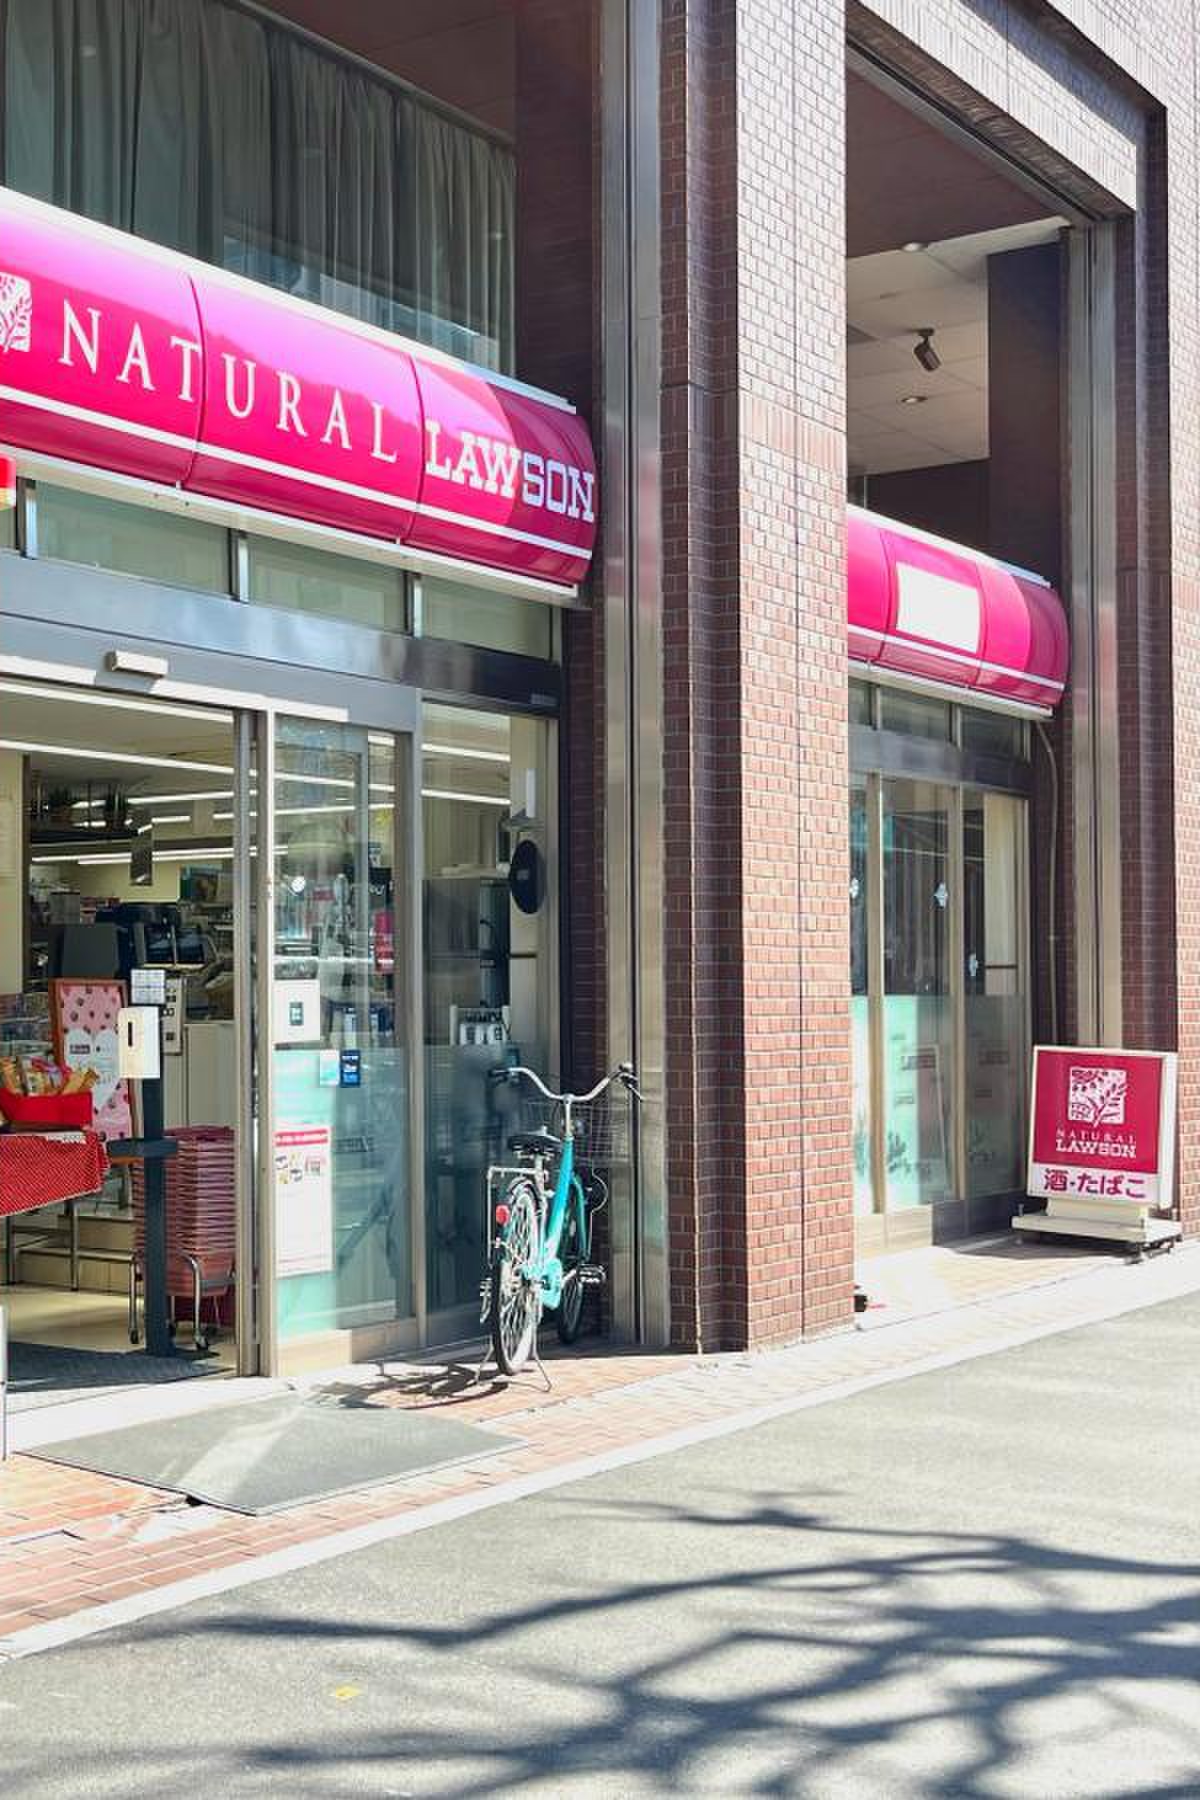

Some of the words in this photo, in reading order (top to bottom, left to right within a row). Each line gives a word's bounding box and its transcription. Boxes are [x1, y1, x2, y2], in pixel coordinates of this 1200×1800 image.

[60, 300, 397, 462] NATURAL
[425, 421, 594, 522] LAWSON
[1056, 1129, 1136, 1144] NATURAL
[1056, 1139, 1137, 1158] LAWSON
